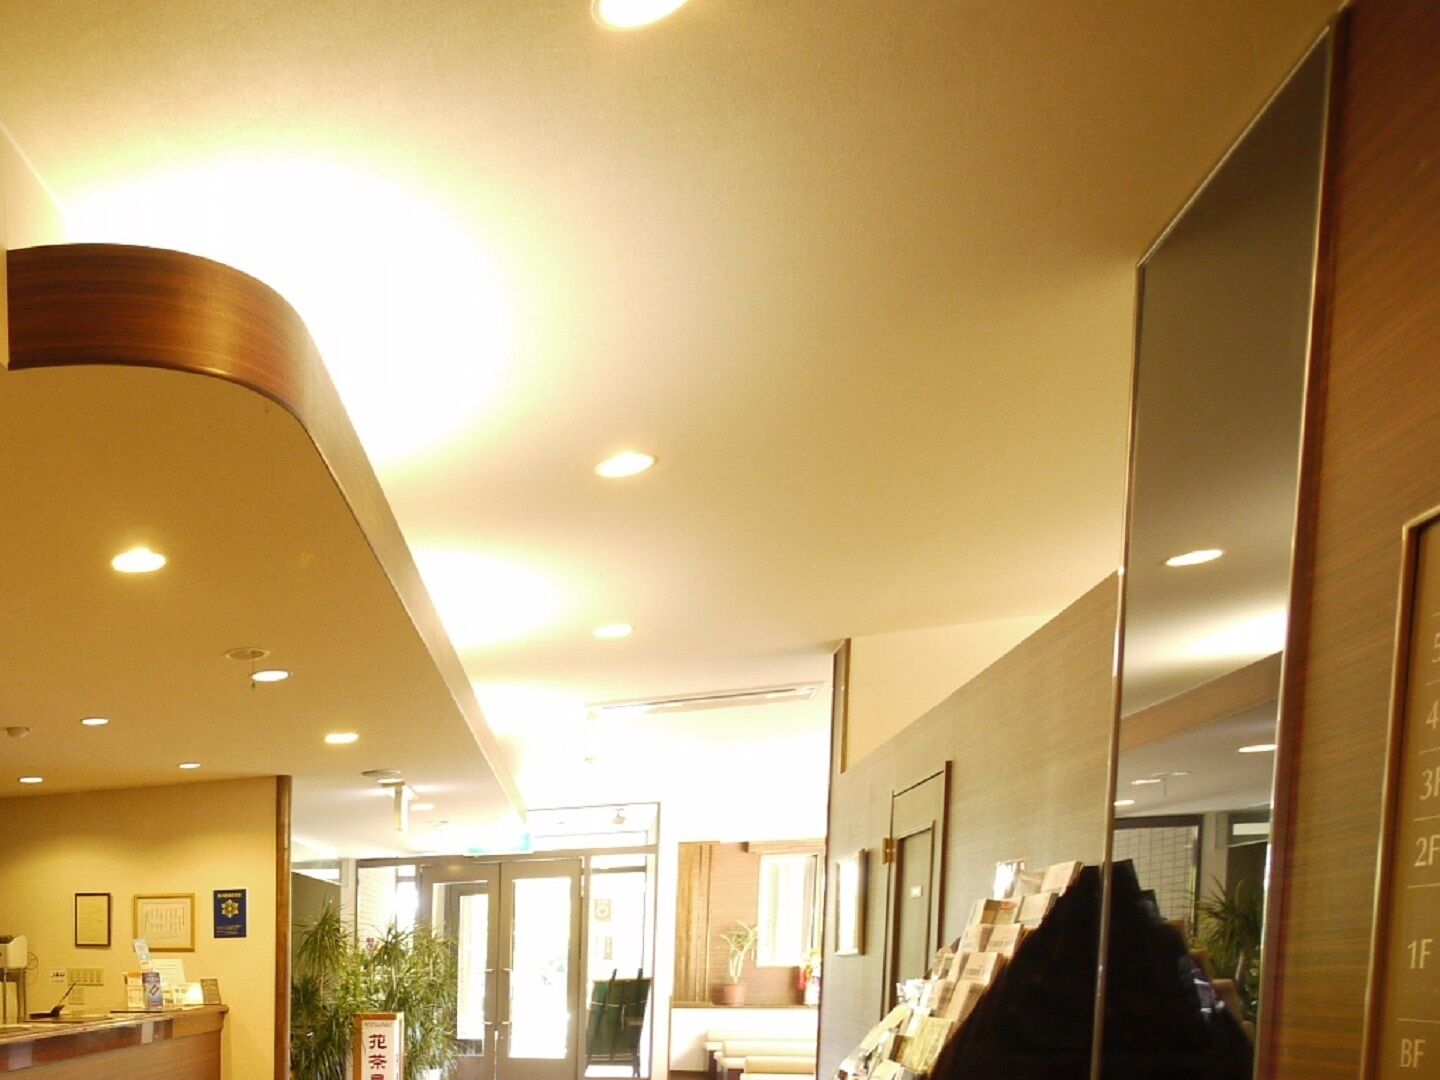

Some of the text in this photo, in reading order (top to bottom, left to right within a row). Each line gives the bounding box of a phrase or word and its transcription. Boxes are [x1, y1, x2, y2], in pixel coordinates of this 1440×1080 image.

[1414, 834, 1440, 868] 2F
[1408, 939, 1433, 970] 1F
[1400, 1039, 1426, 1068] BF
